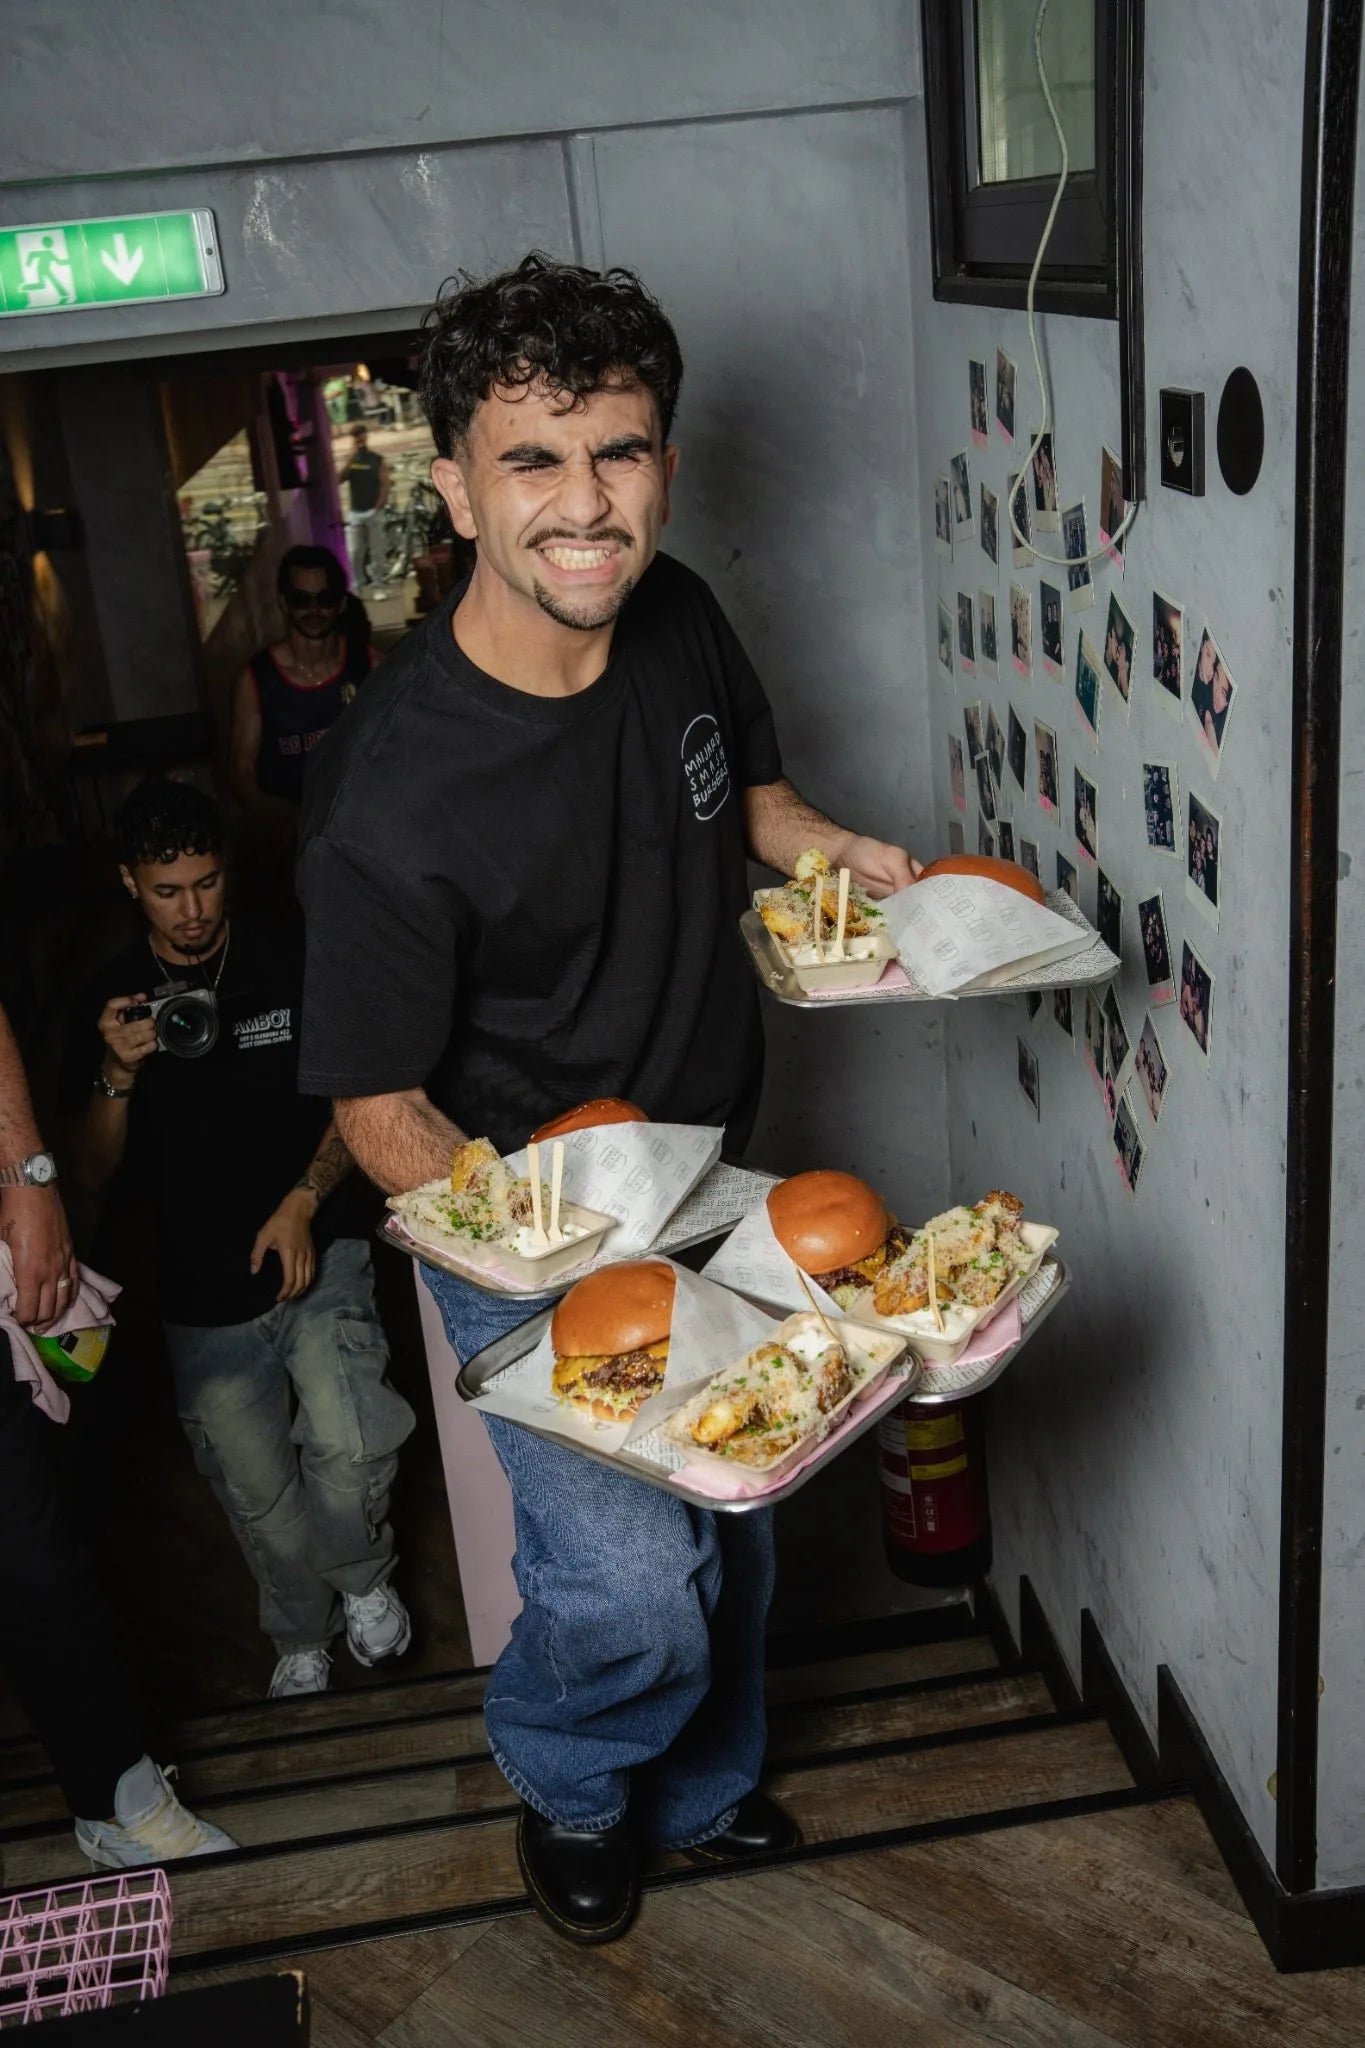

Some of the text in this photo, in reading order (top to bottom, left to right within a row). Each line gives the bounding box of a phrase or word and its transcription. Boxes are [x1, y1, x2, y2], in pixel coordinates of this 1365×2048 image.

[690, 745, 725, 791] SMASH
[692, 761, 728, 807] BURGERS
[233, 1008, 291, 1035] AMBOY
